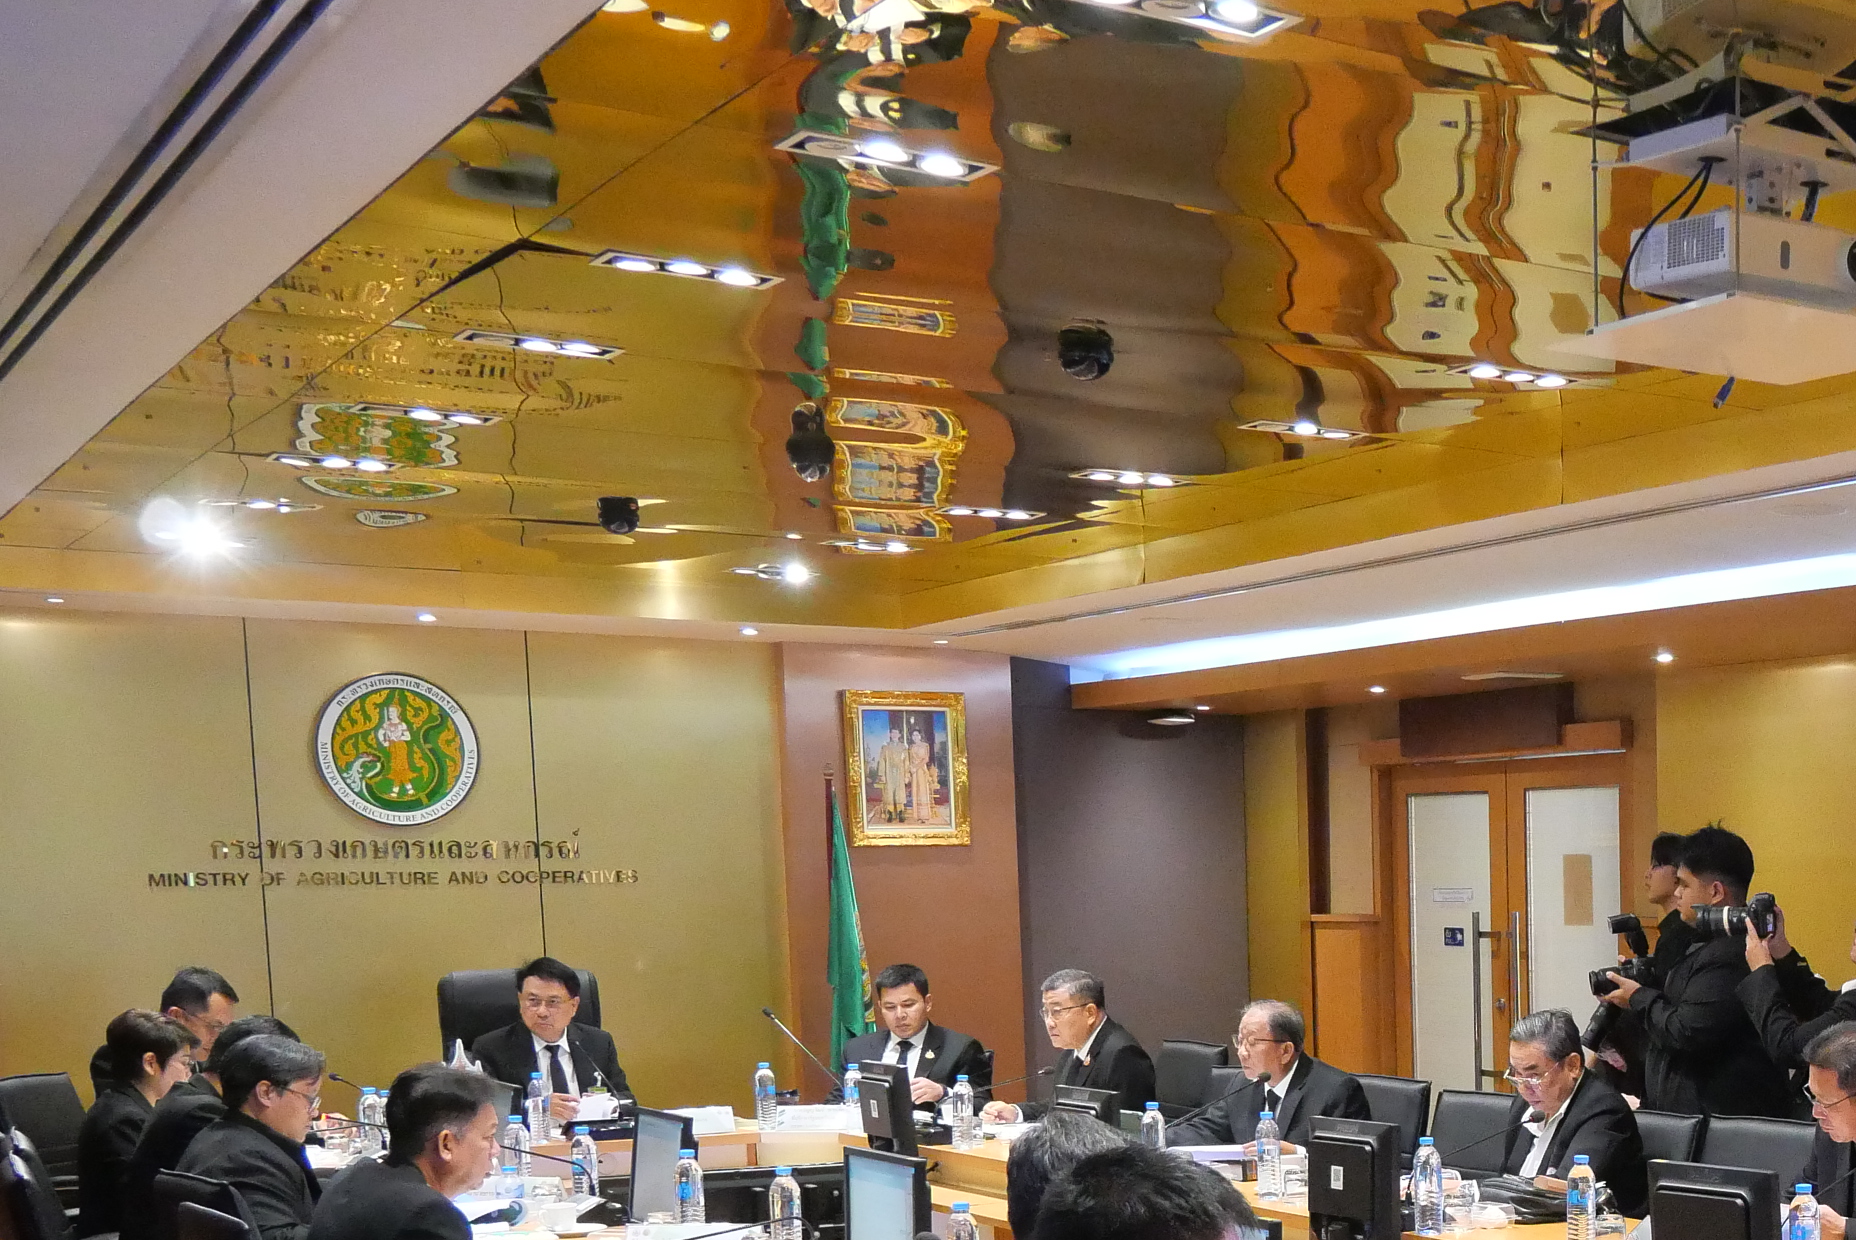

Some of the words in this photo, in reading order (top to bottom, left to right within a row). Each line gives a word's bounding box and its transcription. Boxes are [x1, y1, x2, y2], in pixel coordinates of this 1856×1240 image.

[319, 741, 340, 789] MINISTRY
[338, 786, 352, 801] OF
[349, 797, 420, 823] AGRICULTURE
[420, 808, 440, 822] AND
[440, 749, 476, 811] COOPERATIVES
[148, 871, 249, 888] MINISTRY
[261, 871, 288, 887] OF
[296, 870, 440, 886] AGRICULTURE
[448, 869, 489, 886] AND
[497, 867, 639, 885] COOPERATIVES
